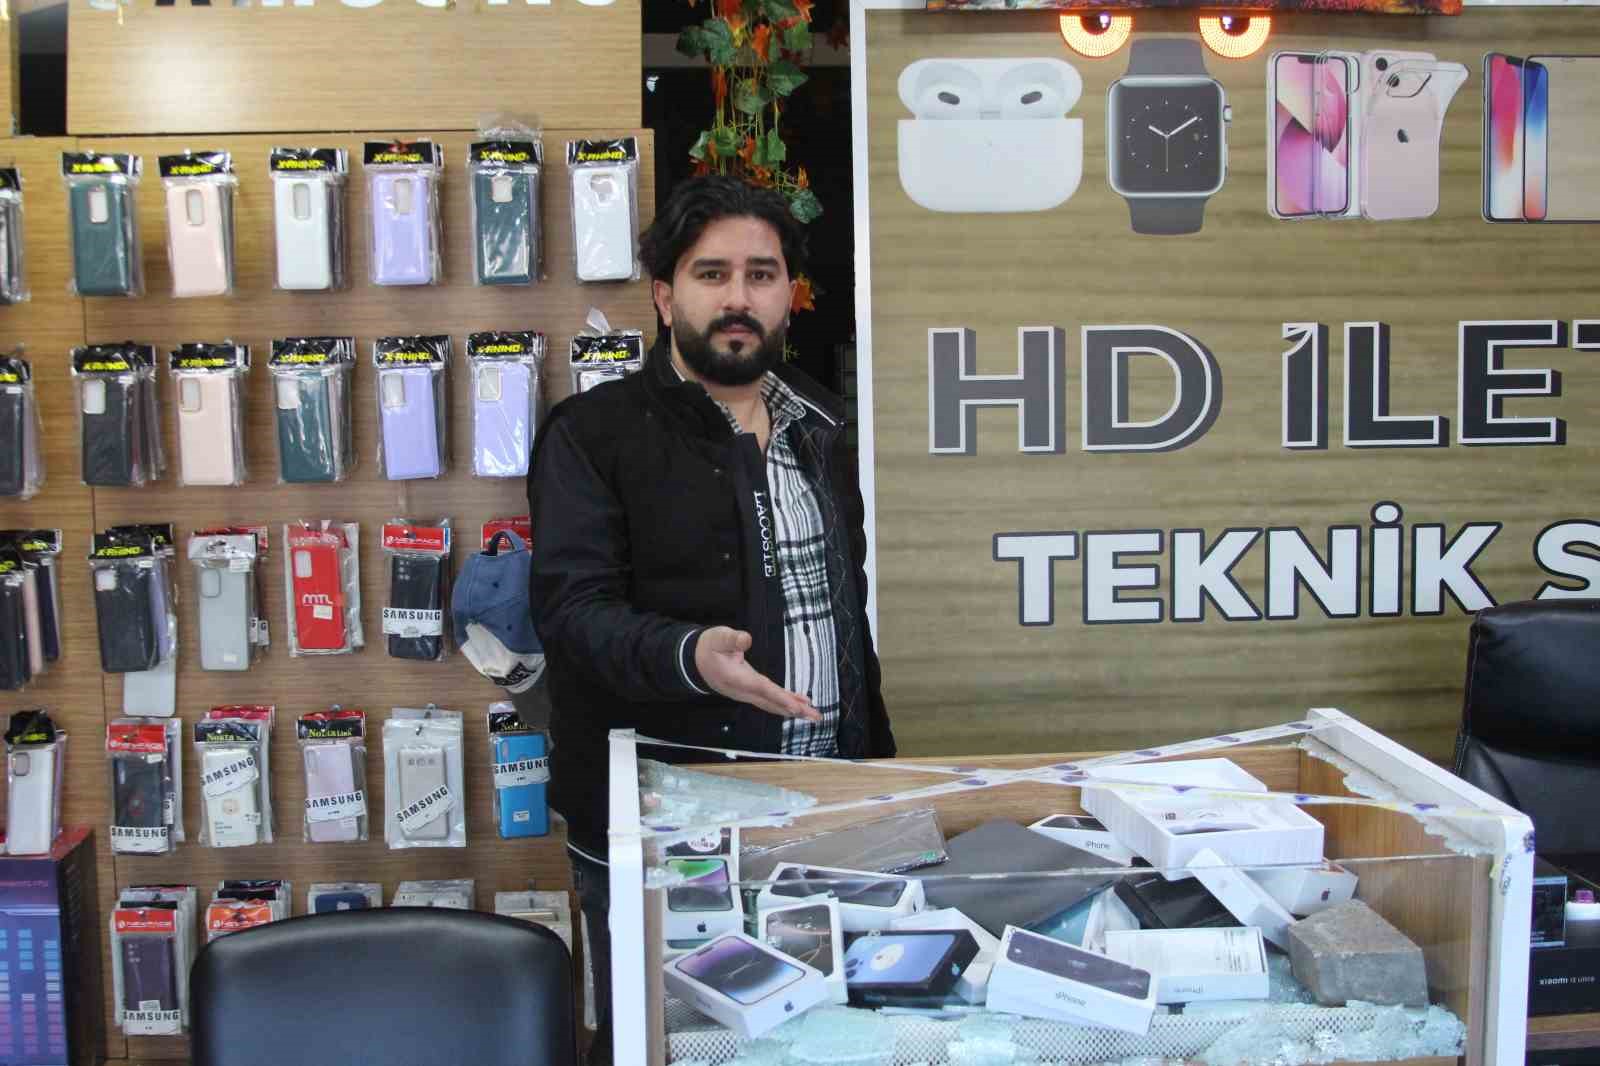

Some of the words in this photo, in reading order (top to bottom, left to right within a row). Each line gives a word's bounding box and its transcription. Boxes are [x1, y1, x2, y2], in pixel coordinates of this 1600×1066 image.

[928, 324, 1222, 455] HD
[1281, 320, 1600, 449] İLE
[754, 490, 777, 577] LACOSTE
[993, 501, 1501, 626] TEKNİK
[383, 609, 441, 621] SAMSUNG
[304, 792, 363, 809] SAMSUNG
[396, 786, 448, 823] SAMSUNG
[111, 827, 167, 838] SAMSUNG
